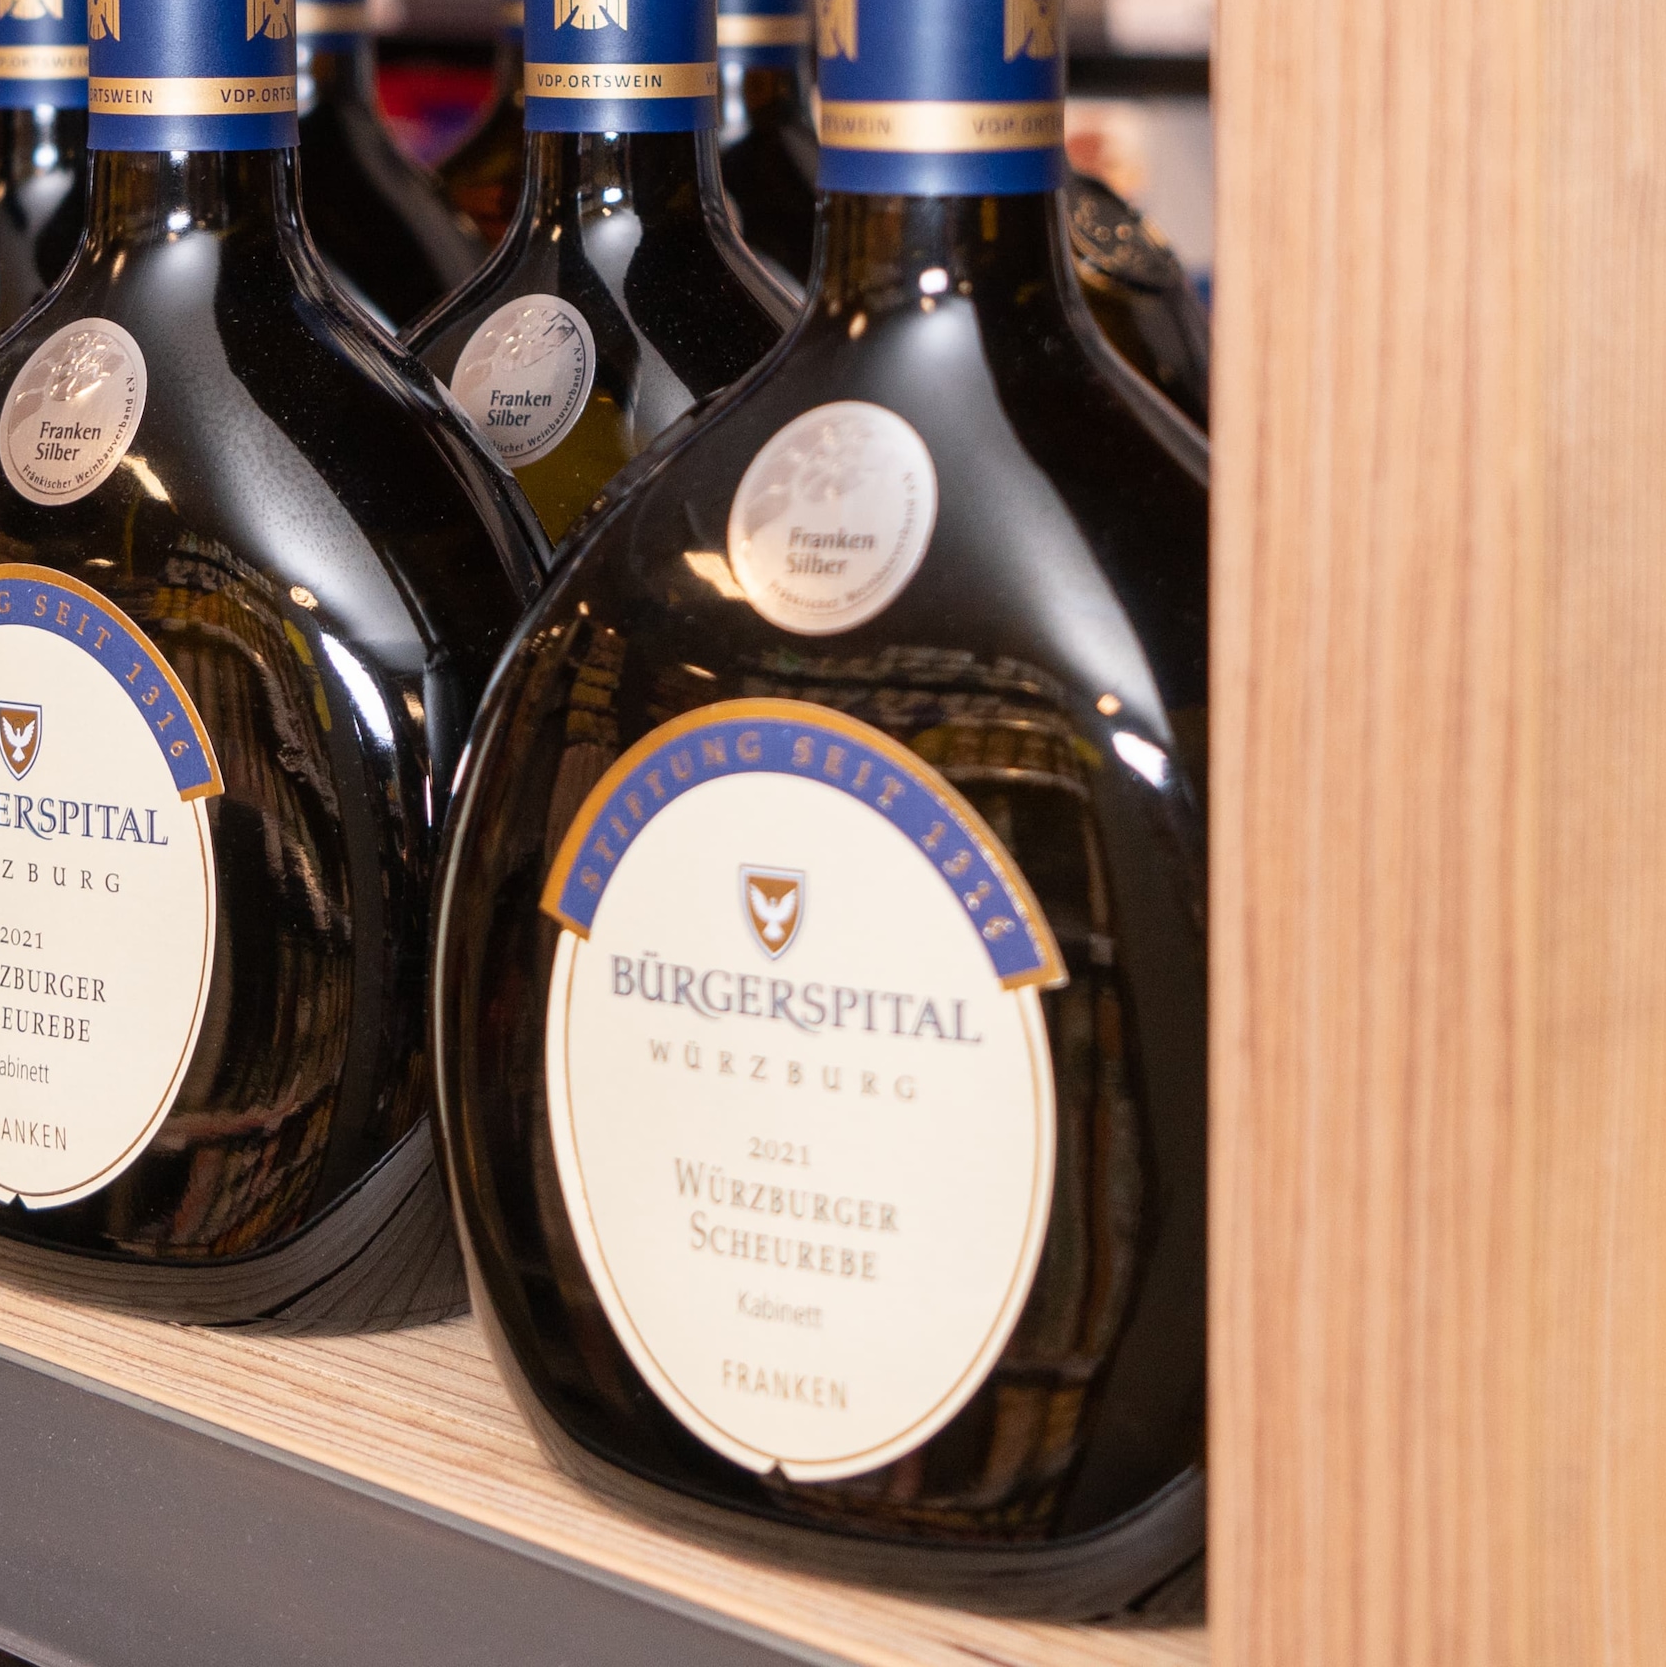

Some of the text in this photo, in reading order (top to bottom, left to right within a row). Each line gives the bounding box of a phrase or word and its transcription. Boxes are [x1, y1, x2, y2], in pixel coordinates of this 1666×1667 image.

[537, 73, 662, 89] VDP.ORTSWEIN
[486, 409, 532, 427] Silber
[490, 389, 552, 407] Franken
[527, 367, 582, 448] Weinbauverband
[22, 464, 72, 490] Fränkischer
[75, 398, 134, 484] Weinbauverband
[39, 421, 102, 441] Franken
[35, 442, 81, 461] Silber
[788, 526, 875, 551] Franken
[786, 552, 848, 575] Silber
[34, 594, 112, 651] SEIT
[125, 662, 190, 758] 1316
[580, 730, 1017, 942] STIFTUNG SEIT 1316
[0, 926, 44, 950] 2021
[609, 949, 984, 1044] BÜRGERSPITAL
[648, 1038, 918, 1102] WÜRZBURG
[748, 1136, 812, 1167] 2021
[673, 1156, 900, 1233] WÜRZBURGER
[688, 1209, 878, 1281] SCHEUREBE
[736, 1289, 824, 1329] Kabinett
[721, 1358, 849, 1411] FRANKEN
